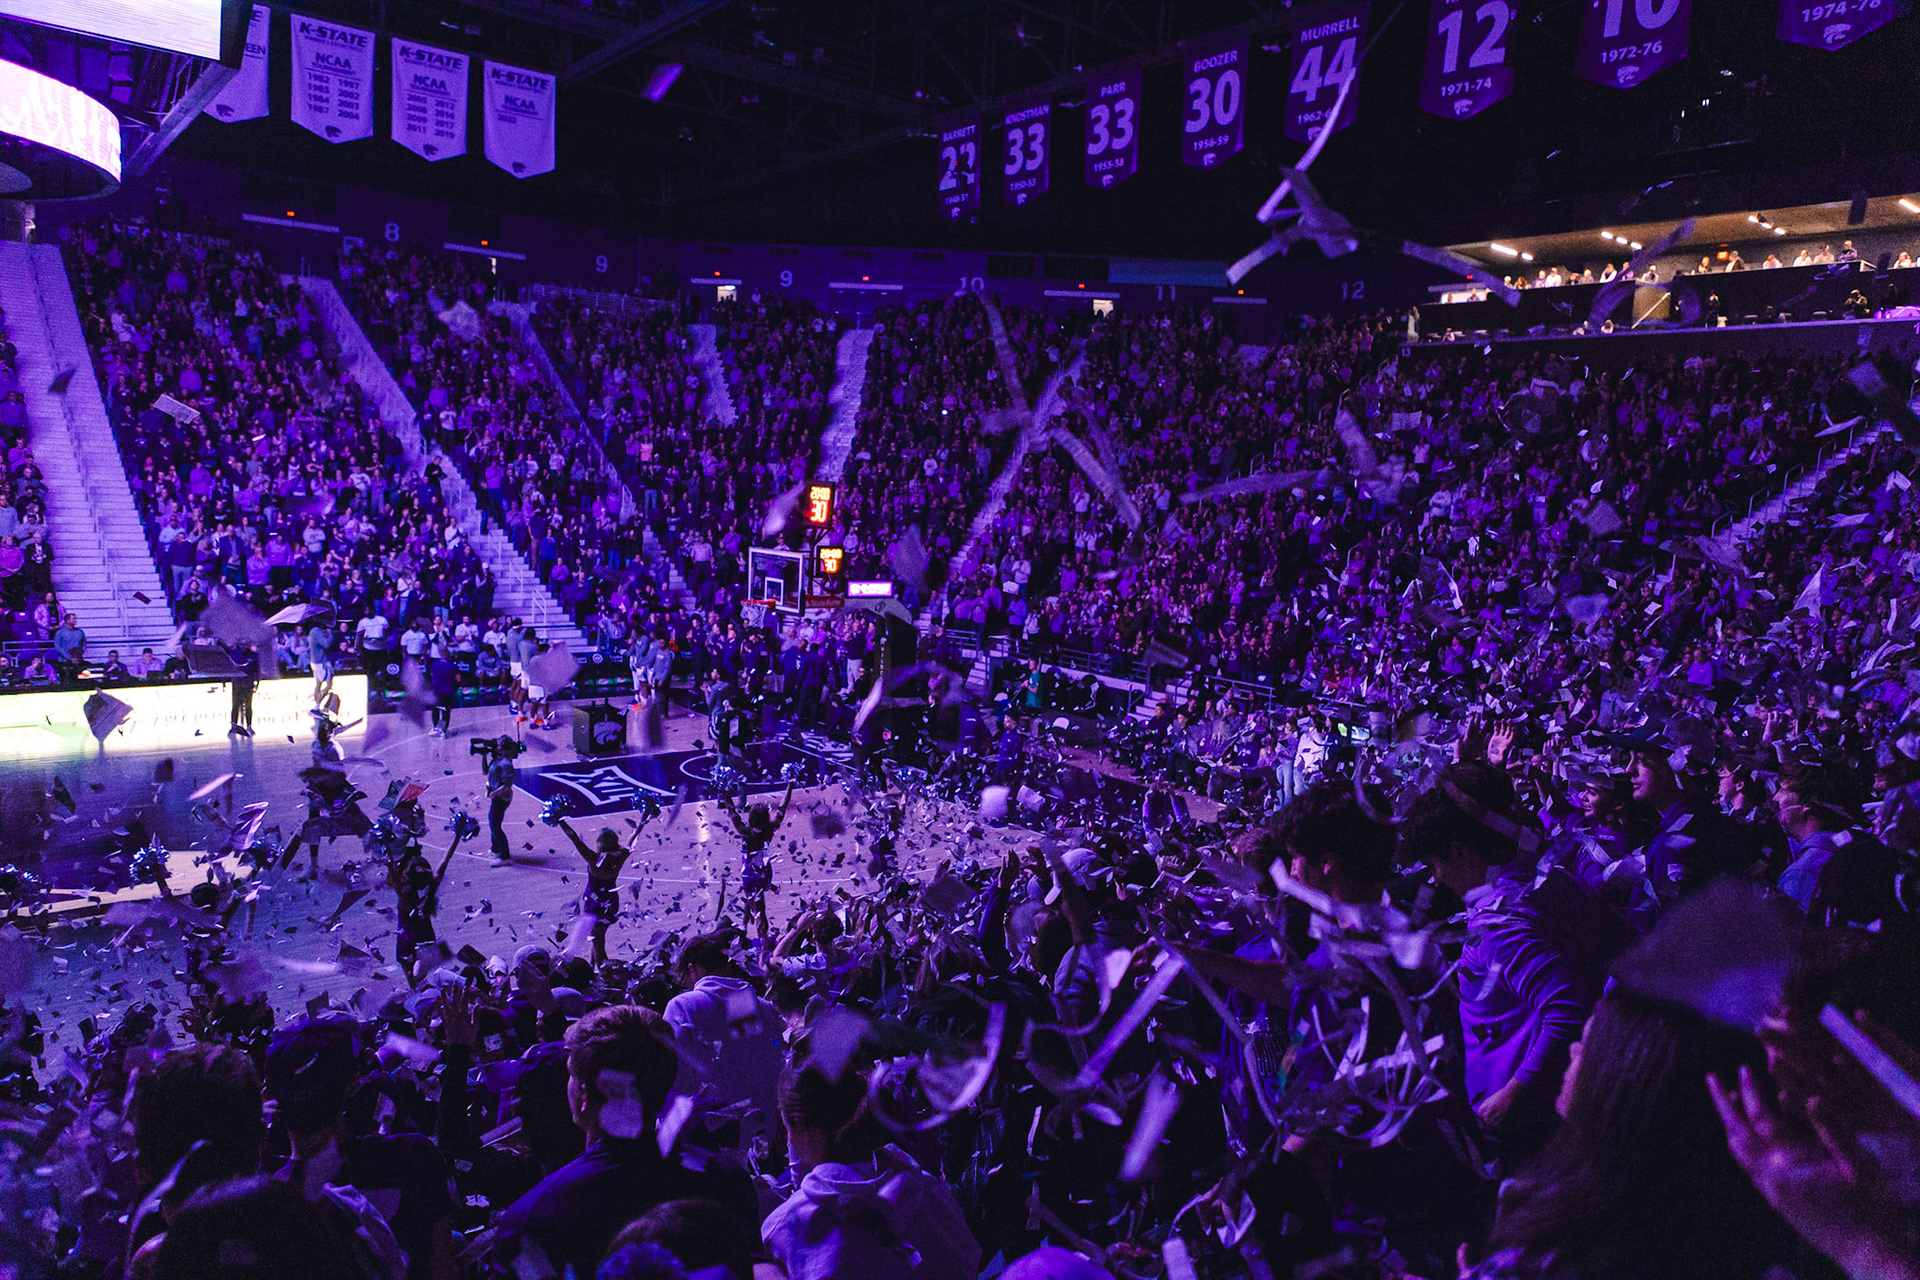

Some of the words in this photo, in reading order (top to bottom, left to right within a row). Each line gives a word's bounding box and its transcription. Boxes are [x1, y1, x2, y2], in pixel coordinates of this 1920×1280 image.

[300, 22, 368, 48] K-STATE
[1300, 16, 1360, 43] MURRELL
[1438, 0, 1509, 74] 12
[315, 52, 352, 69] NCAA
[400, 45, 462, 70] K-STATE
[1193, 50, 1238, 73] BOOZER
[1601, 40, 1663, 64] 1972-76
[491, 68, 550, 90] K-STATE
[1290, 36, 1357, 104] 44
[413, 74, 447, 91] NCAA
[1100, 82, 1126, 98] PARR
[1441, 77, 1493, 97] 1971-74
[504, 95, 536, 111] NCAA
[1185, 70, 1241, 133] 30
[1087, 98, 1135, 156] 33
[1004, 122, 1045, 176] 33
[1193, 134, 1230, 152] 1956-59
[384, 222, 400, 242] 8
[595, 255, 608, 273] 9
[780, 270, 793, 288] 9
[960, 276, 985, 291] 10
[1156, 285, 1176, 301] 11
[1341, 281, 1365, 300] 12
[810, 486, 832, 501] 20:00
[810, 500, 827, 523] 30
[820, 548, 843, 559] 20:00
[824, 559, 838, 573] 30
